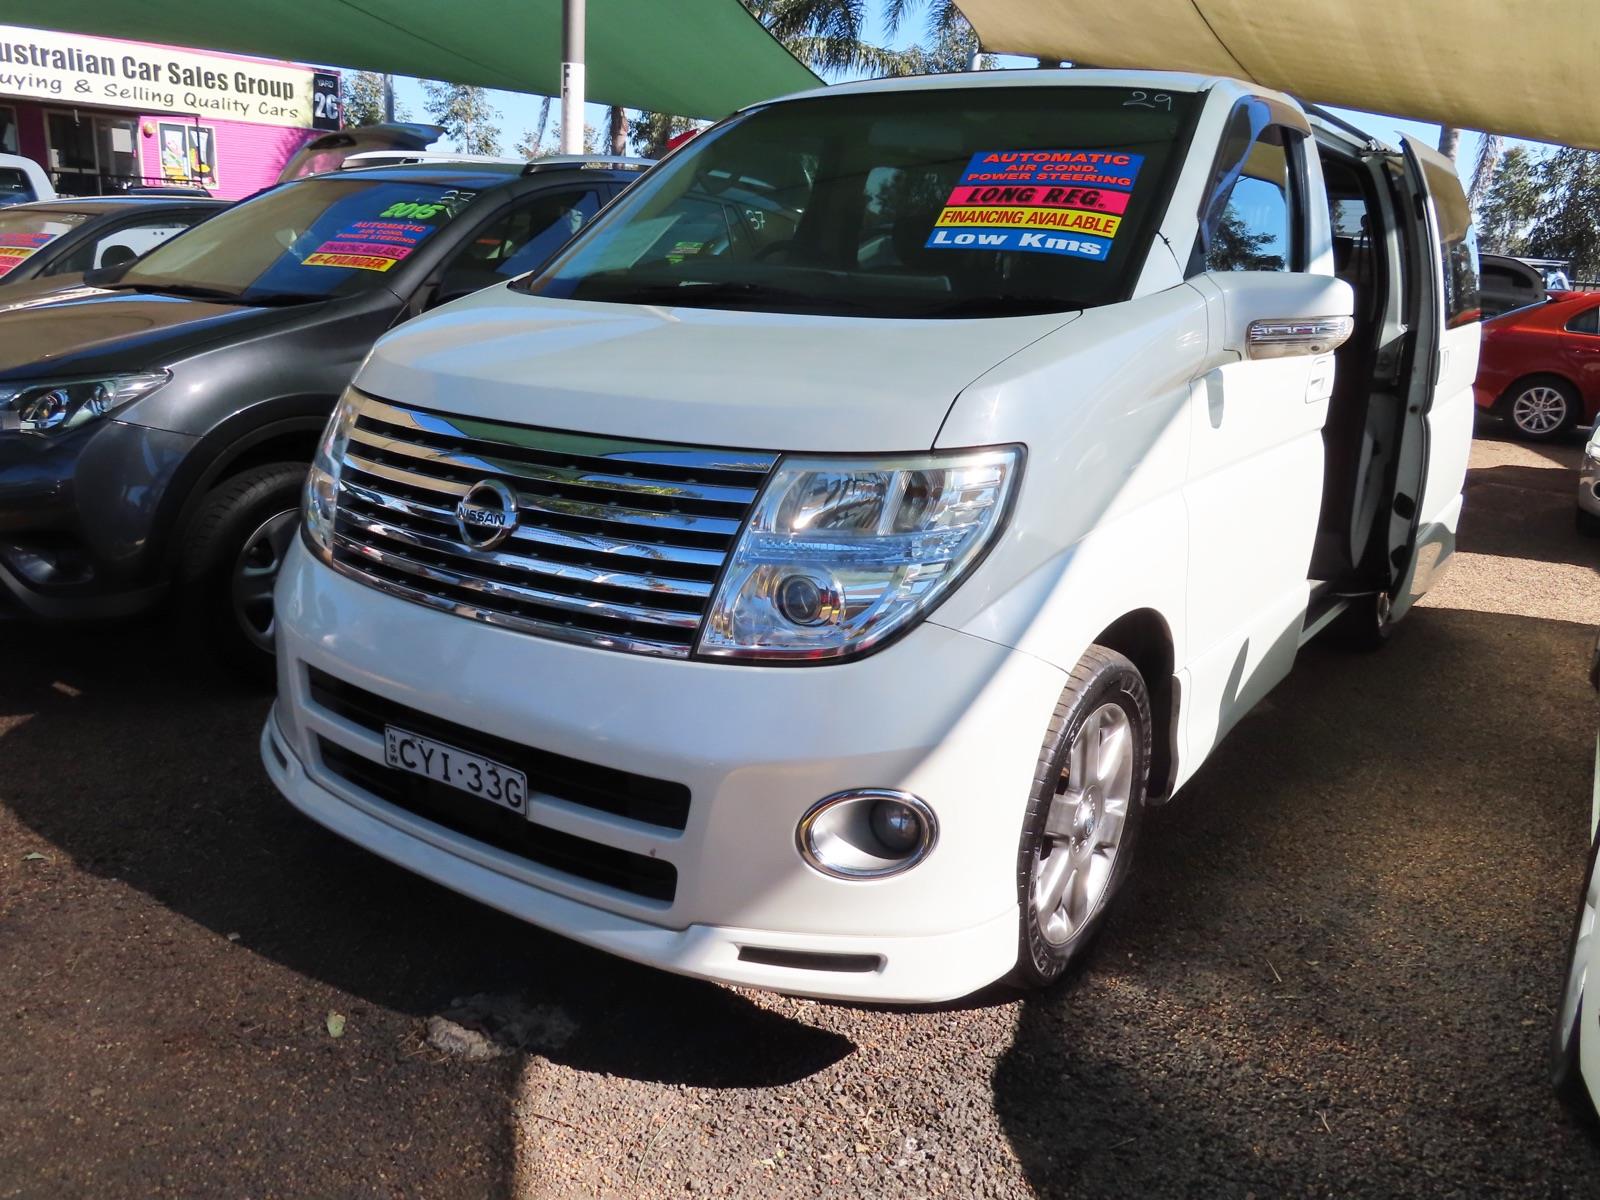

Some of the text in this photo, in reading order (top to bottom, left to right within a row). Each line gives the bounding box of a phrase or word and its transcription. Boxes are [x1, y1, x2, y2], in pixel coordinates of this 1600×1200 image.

[0, 42, 294, 100] ustralian Car Sales Group
[0, 73, 299, 119] uying & Selling Quality Cars
[1123, 91, 1171, 111] 29
[983, 153, 1130, 165] AUTOMATIC
[1005, 164, 1099, 173] AIR COND.
[967, 173, 1132, 186] POWER STEERING
[965, 187, 1105, 208] LONG REG.
[380, 202, 446, 219] 2015
[352, 221, 426, 232] AUTOMATIC
[941, 210, 1116, 234] FINANCING AVAILABLE
[933, 231, 1102, 255] Low Kms
[459, 502, 506, 525] NISSAN
